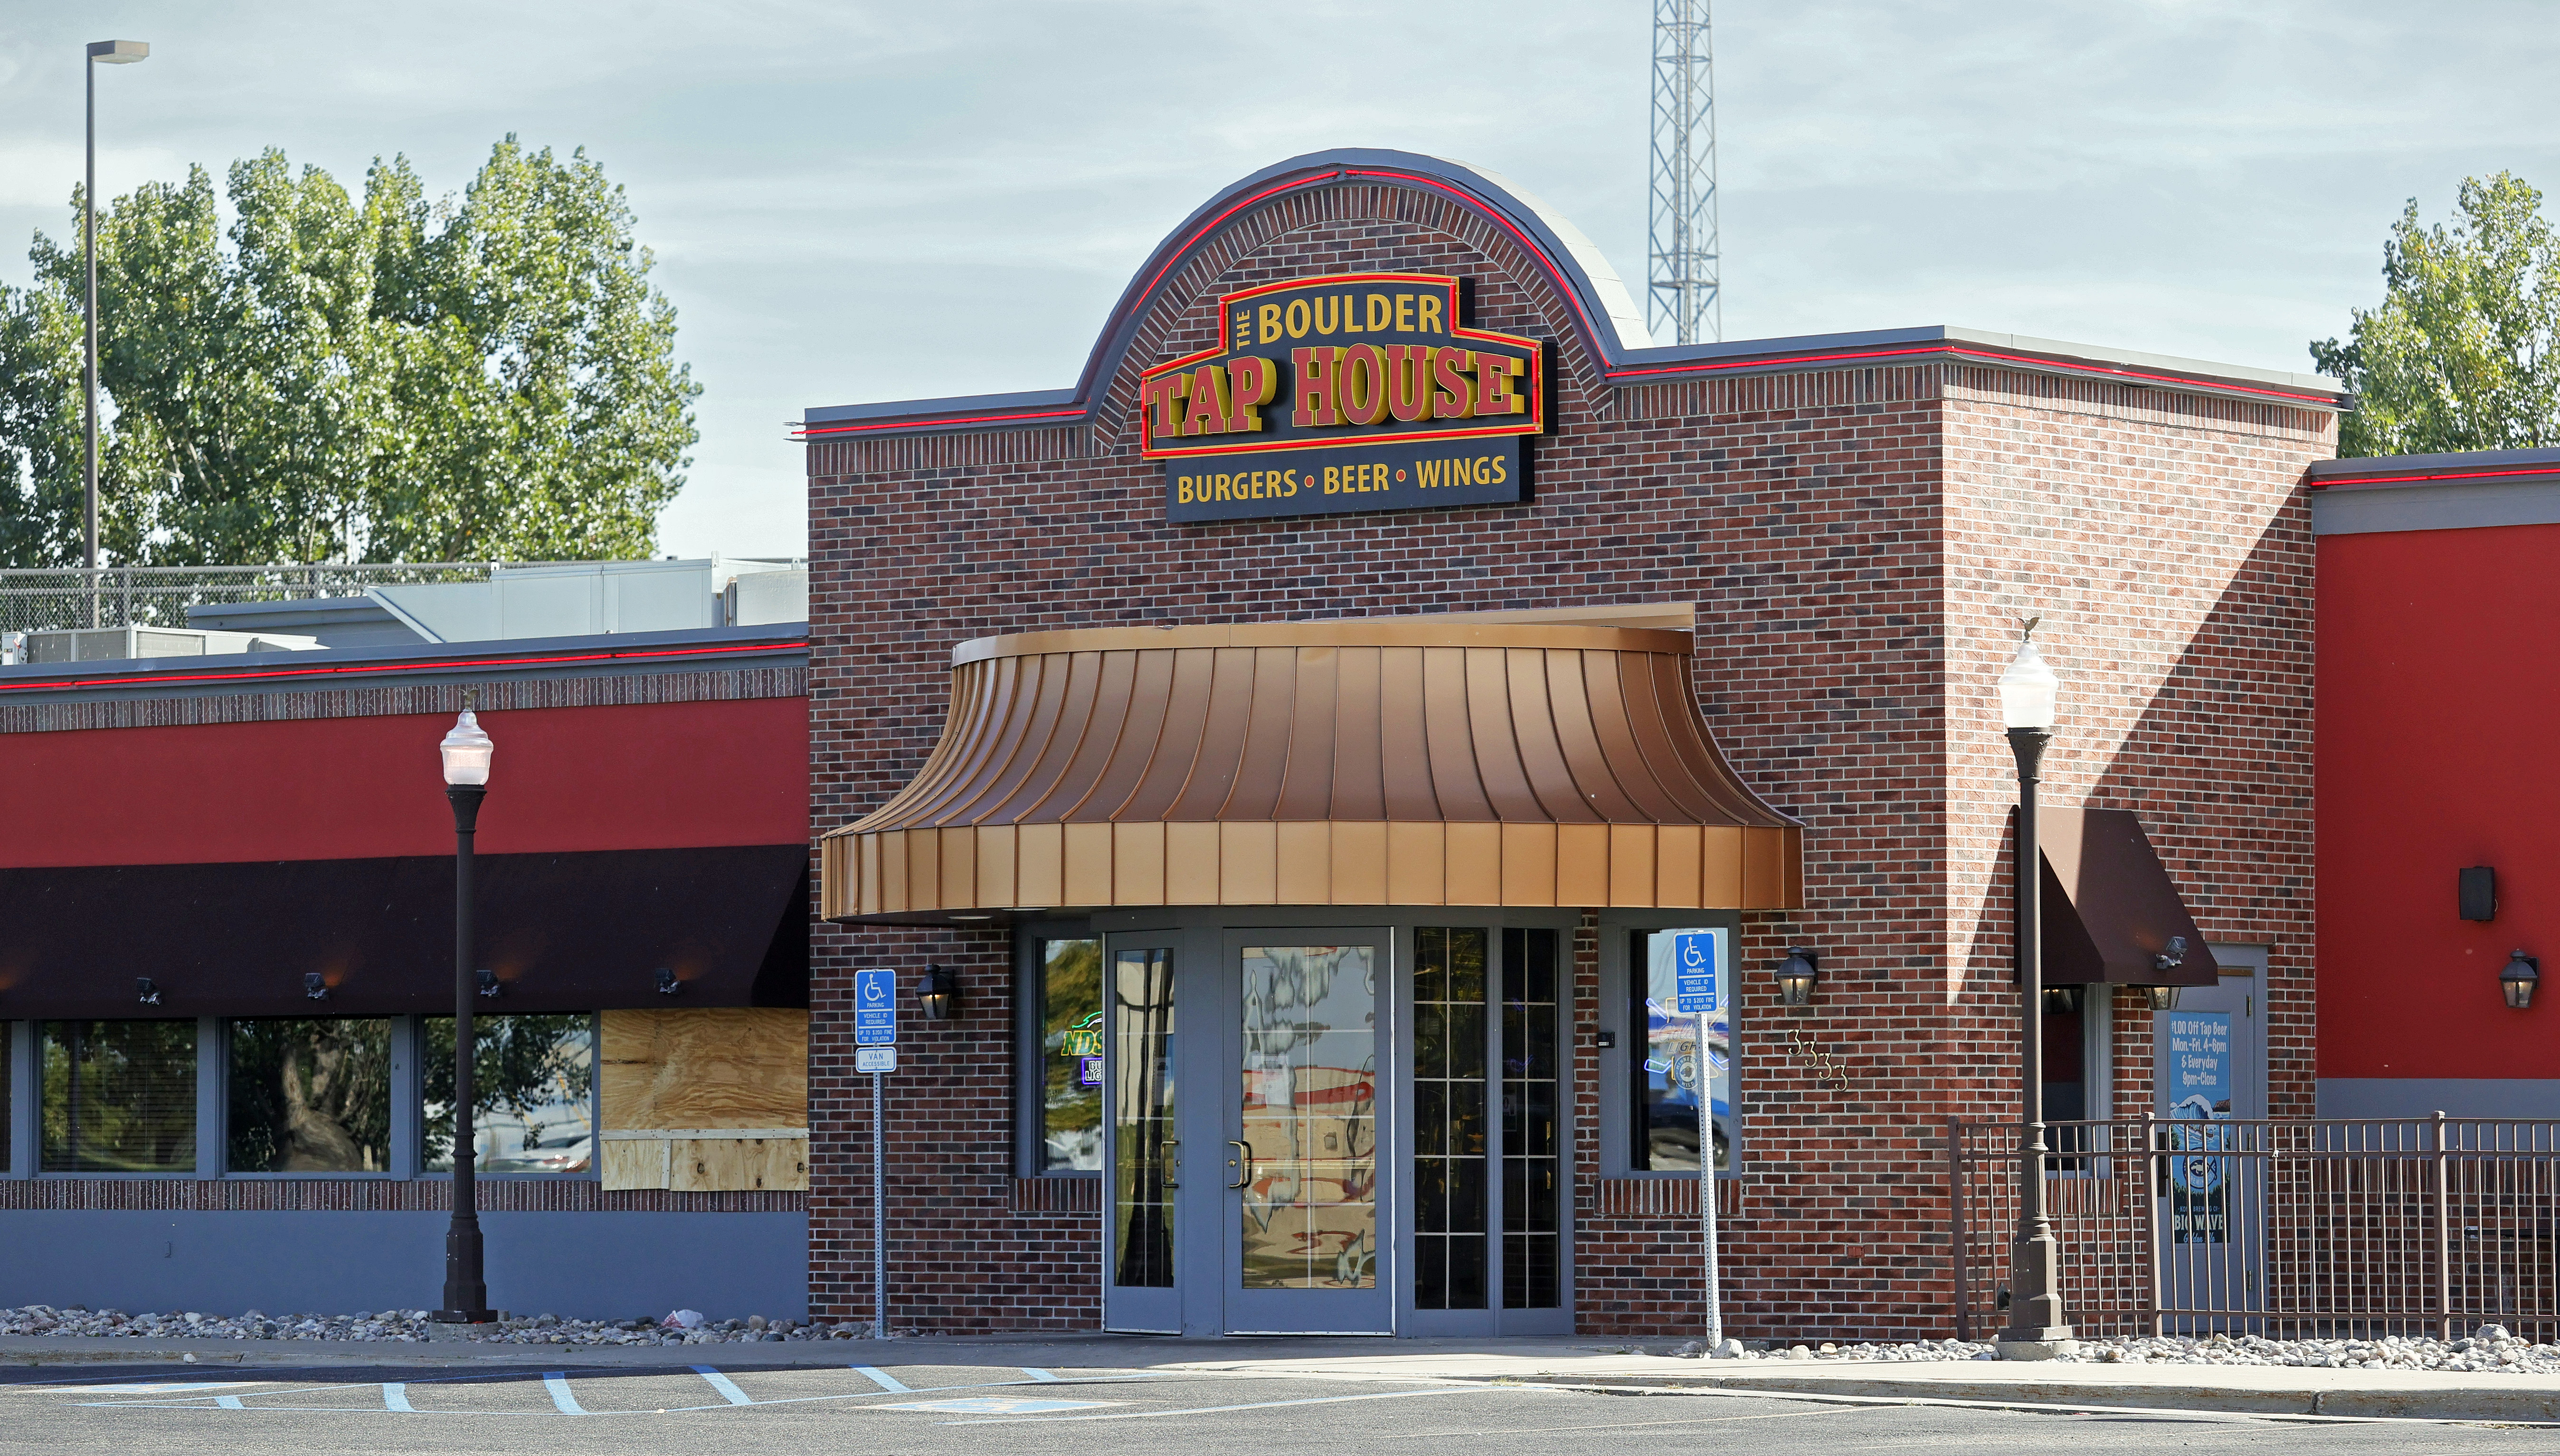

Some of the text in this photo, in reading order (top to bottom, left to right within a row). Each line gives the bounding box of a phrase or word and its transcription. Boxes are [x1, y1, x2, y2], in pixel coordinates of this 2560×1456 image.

[1259, 293, 1443, 345] BOULDER
[1236, 310, 1250, 350] THE
[1145, 343, 1525, 437] TAP HOUSE
[1178, 455, 1507, 504] BURGERS BEER WINGS
[2171, 1021, 2228, 1038] $1.00 Off Tap Beer
[1061, 1030, 1102, 1056] NDS
[1667, 1041, 1696, 1053] LIGH
[2172, 1037, 2227, 1054] Mon.-Fri. 4-6pm
[1089, 1061, 1102, 1071] BU
[1788, 1029, 1849, 1092] 3333
[2181, 1054, 2218, 1071] & Everyday
[1085, 1071, 1102, 1081] LIG
[2182, 1071, 2217, 1087] 9pm-Close
[2183, 1232, 2203, 1243] Glden
